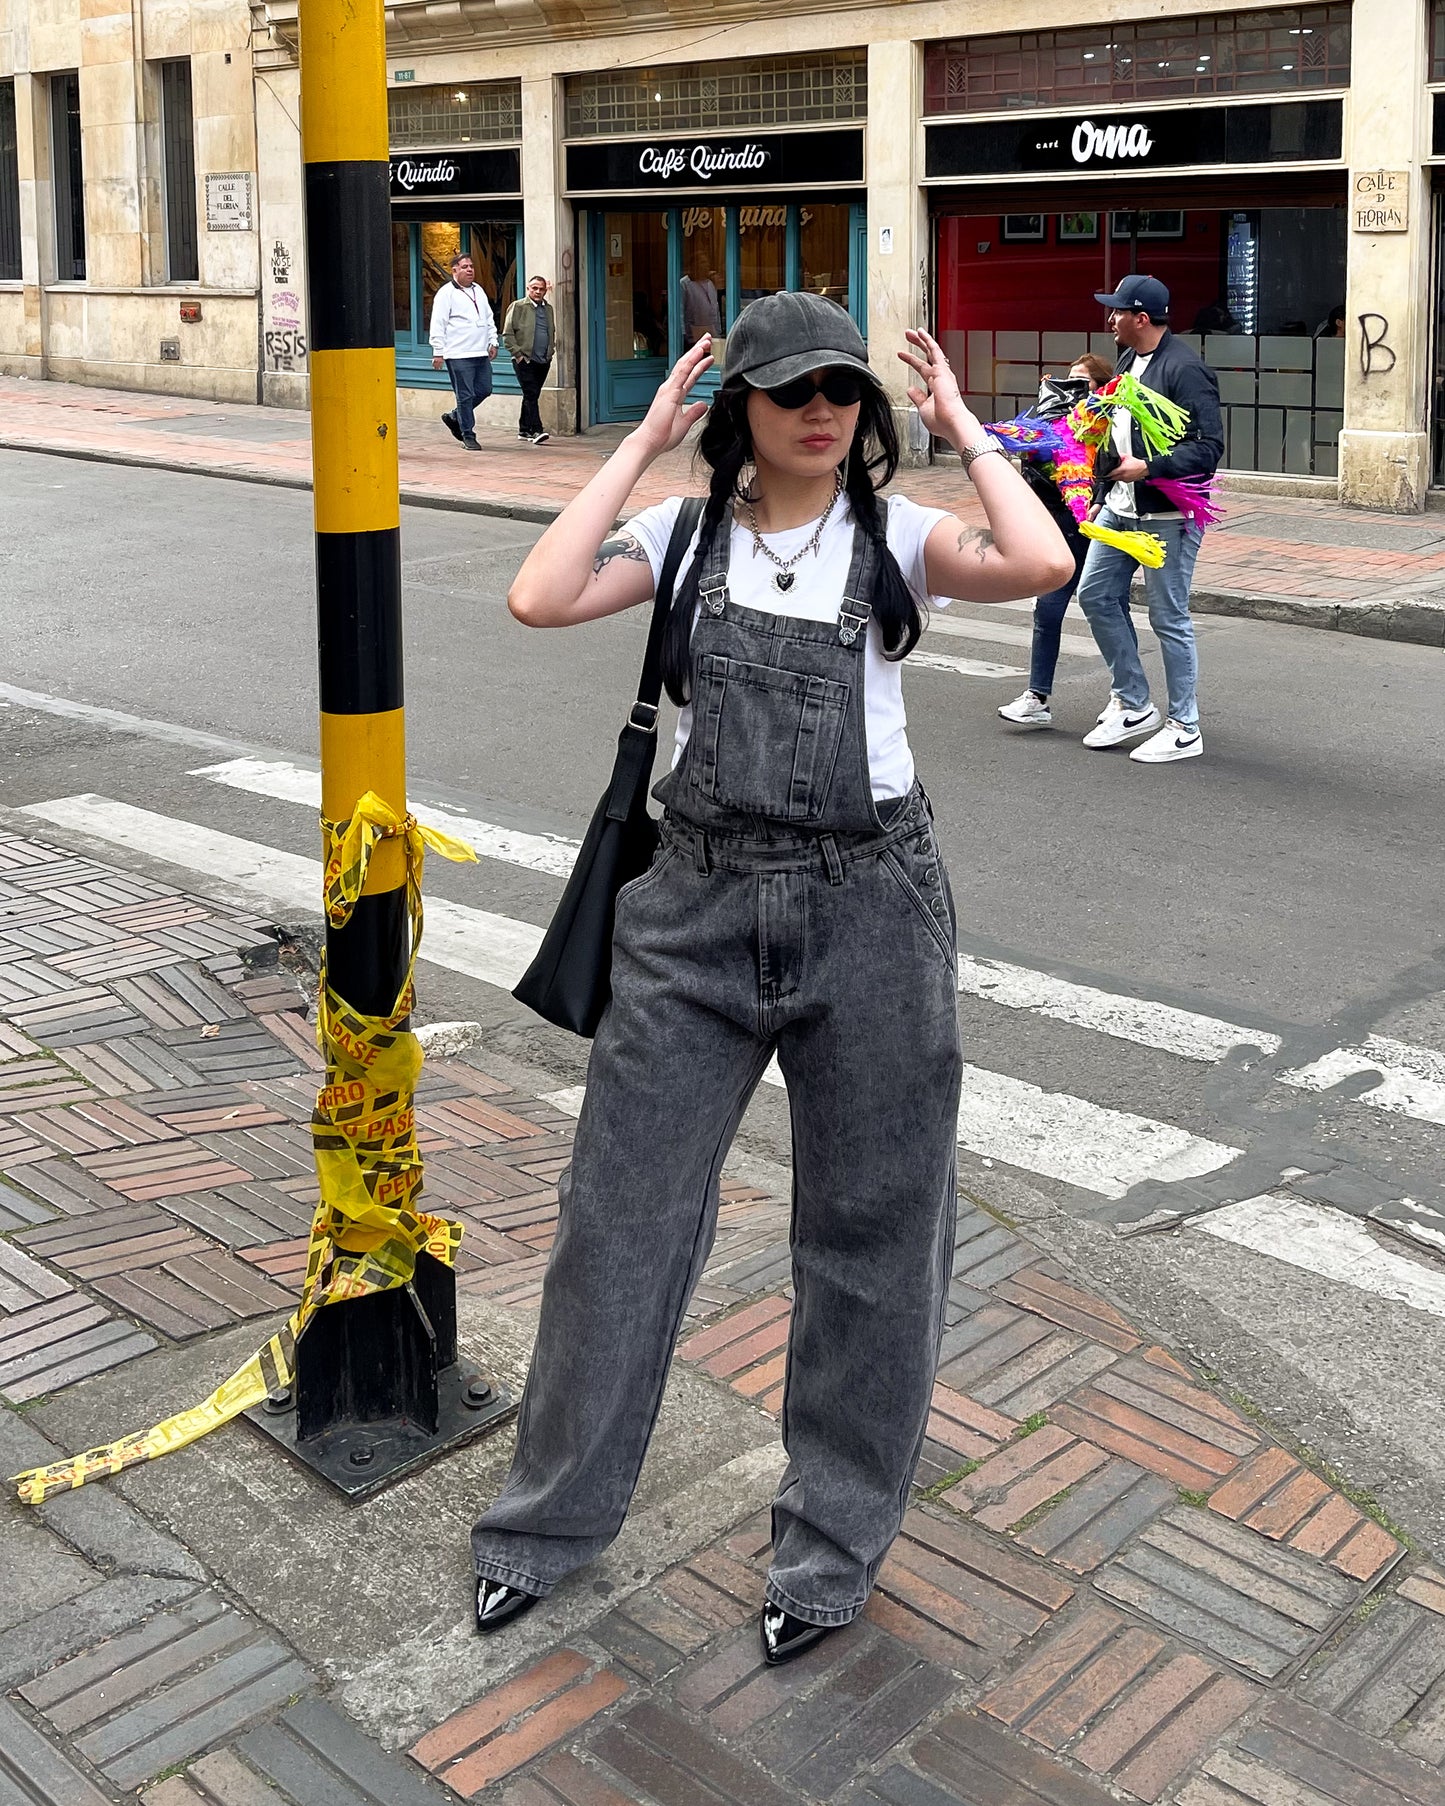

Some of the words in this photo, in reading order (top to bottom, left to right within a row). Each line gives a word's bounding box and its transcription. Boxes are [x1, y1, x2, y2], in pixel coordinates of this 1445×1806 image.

[1036, 140, 1058, 149] CAFÉ
[639, 148, 686, 178] Café
[690, 145, 765, 179] Quindío
[397, 160, 454, 190] Quindío
[1357, 174, 1395, 192] CALLE
[218, 183, 235, 191] CALLE
[1356, 209, 1401, 227] FLORIAN
